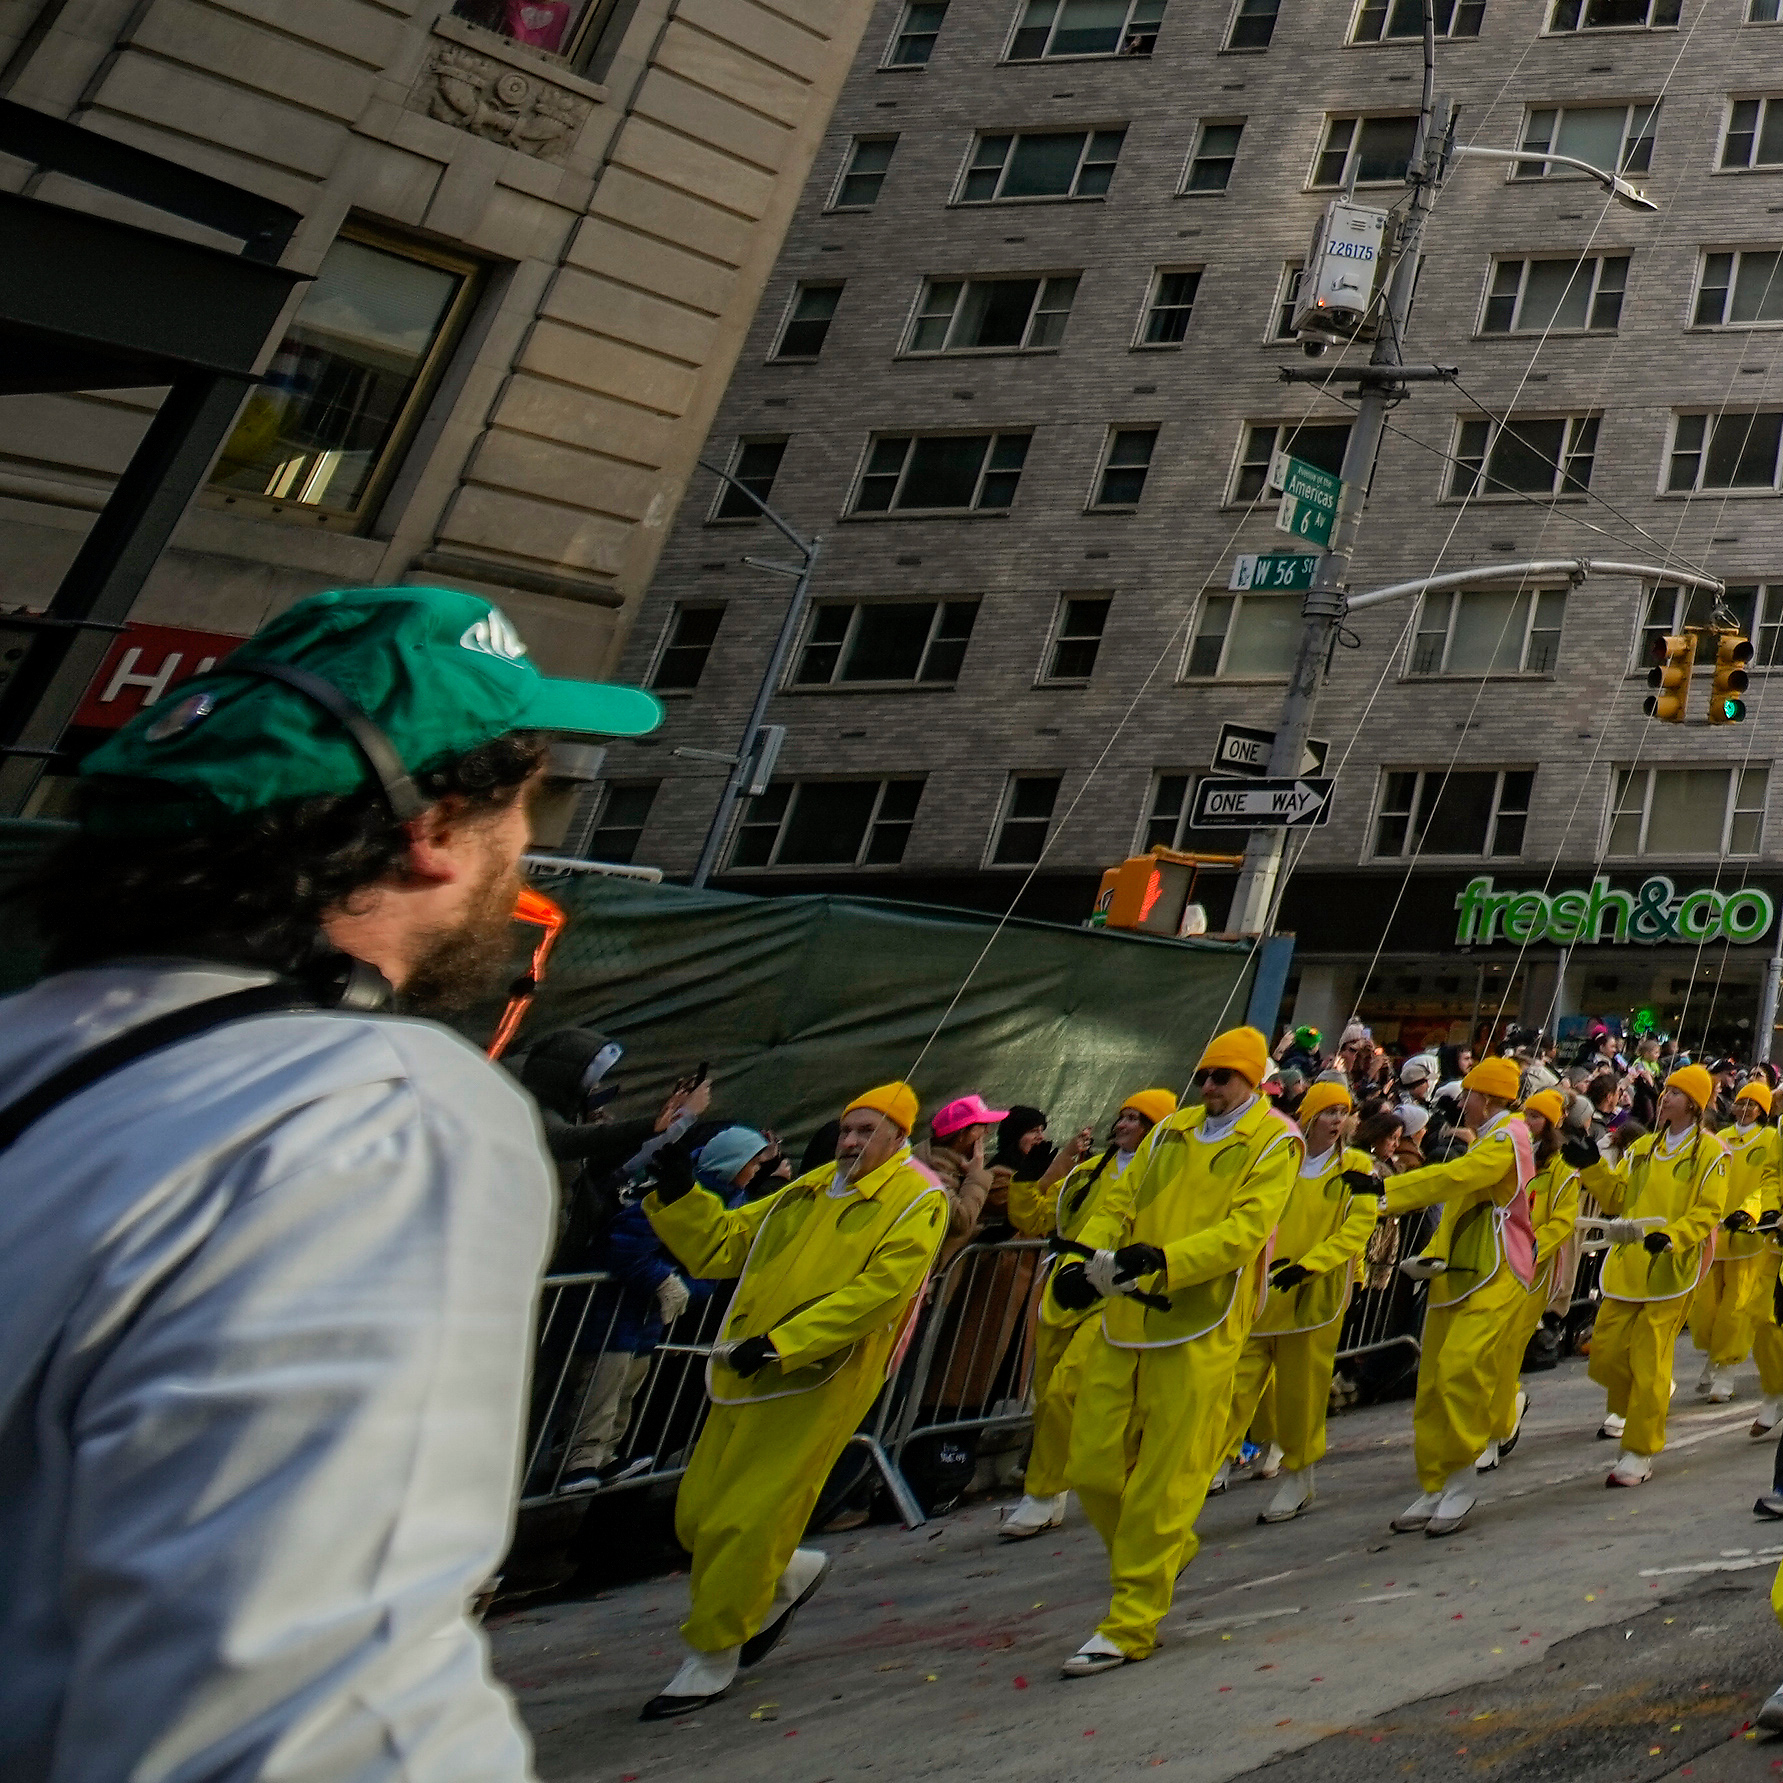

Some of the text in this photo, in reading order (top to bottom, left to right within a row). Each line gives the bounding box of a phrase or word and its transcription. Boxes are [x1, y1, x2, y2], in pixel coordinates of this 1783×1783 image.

[1329, 240, 1373, 260] 726175
[1288, 476, 1334, 509] Americas
[1300, 509, 1327, 534] 6 Av
[1254, 560, 1272, 585] W
[1273, 561, 1297, 586] 56
[1229, 740, 1261, 762] ONE
[1210, 792, 1311, 812] ONE WAY
[1455, 876, 1774, 946] fresh&co
